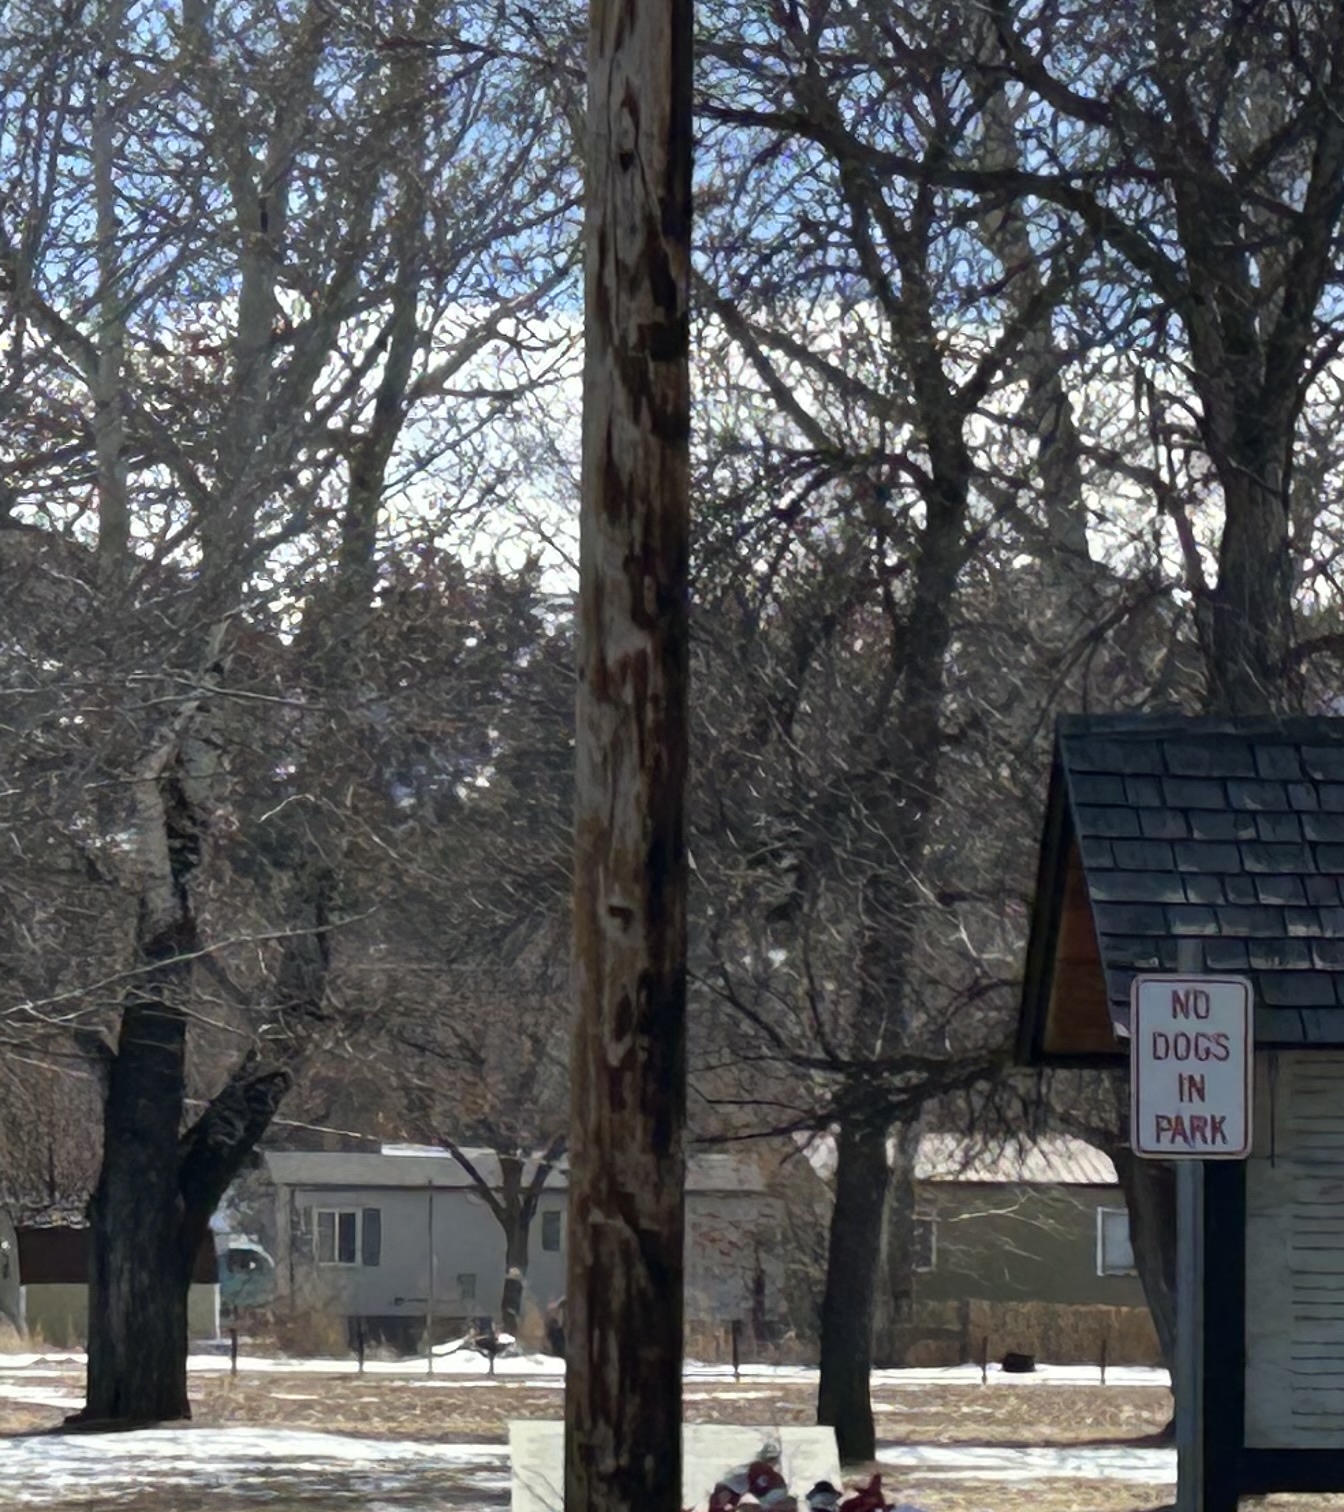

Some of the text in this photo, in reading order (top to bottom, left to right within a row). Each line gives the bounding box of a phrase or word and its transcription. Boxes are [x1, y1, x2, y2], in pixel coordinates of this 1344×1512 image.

[1171, 988, 1210, 1019] NO
[1152, 1031, 1231, 1062] DOGS
[1178, 1073, 1205, 1103] IN
[1154, 1113, 1228, 1146] PARK
